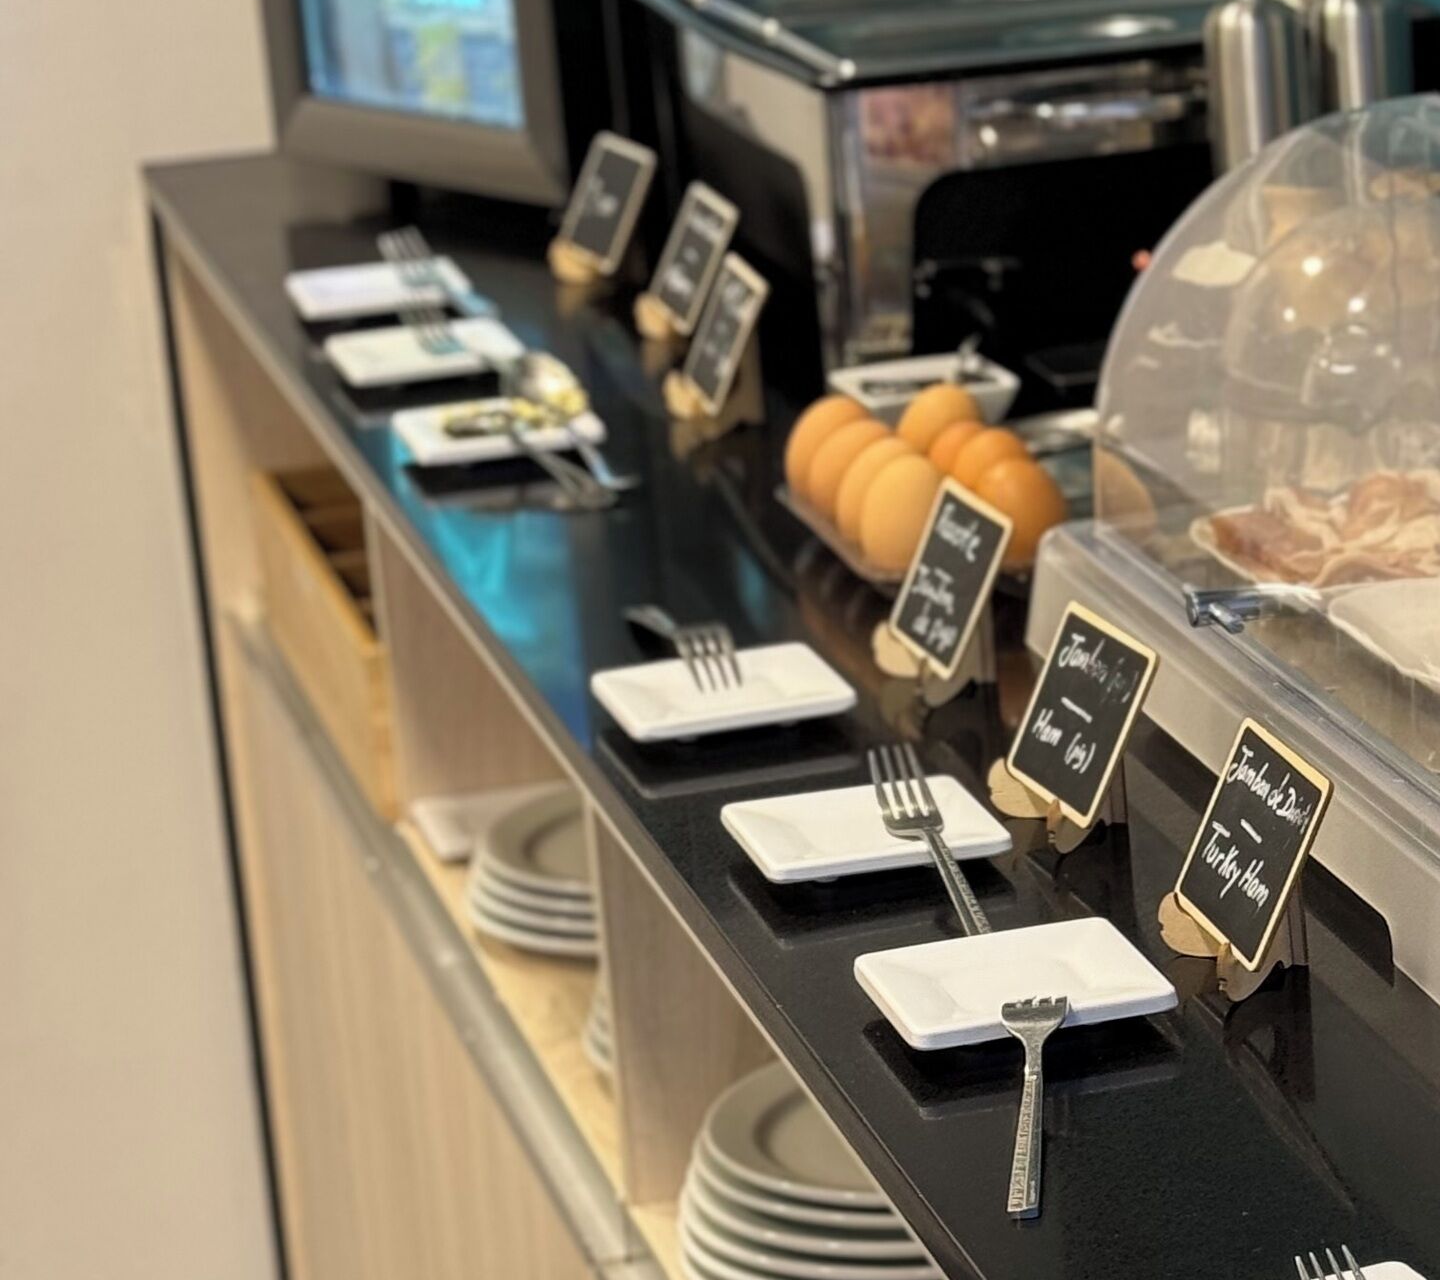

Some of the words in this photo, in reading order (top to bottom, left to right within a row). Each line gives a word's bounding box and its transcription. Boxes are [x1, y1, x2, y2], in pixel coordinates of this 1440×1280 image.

[1032, 708, 1063, 746] Ham
[1227, 745, 1270, 802] Jambon
[1266, 773, 1290, 811] de
[1238, 859, 1270, 910] Ham
